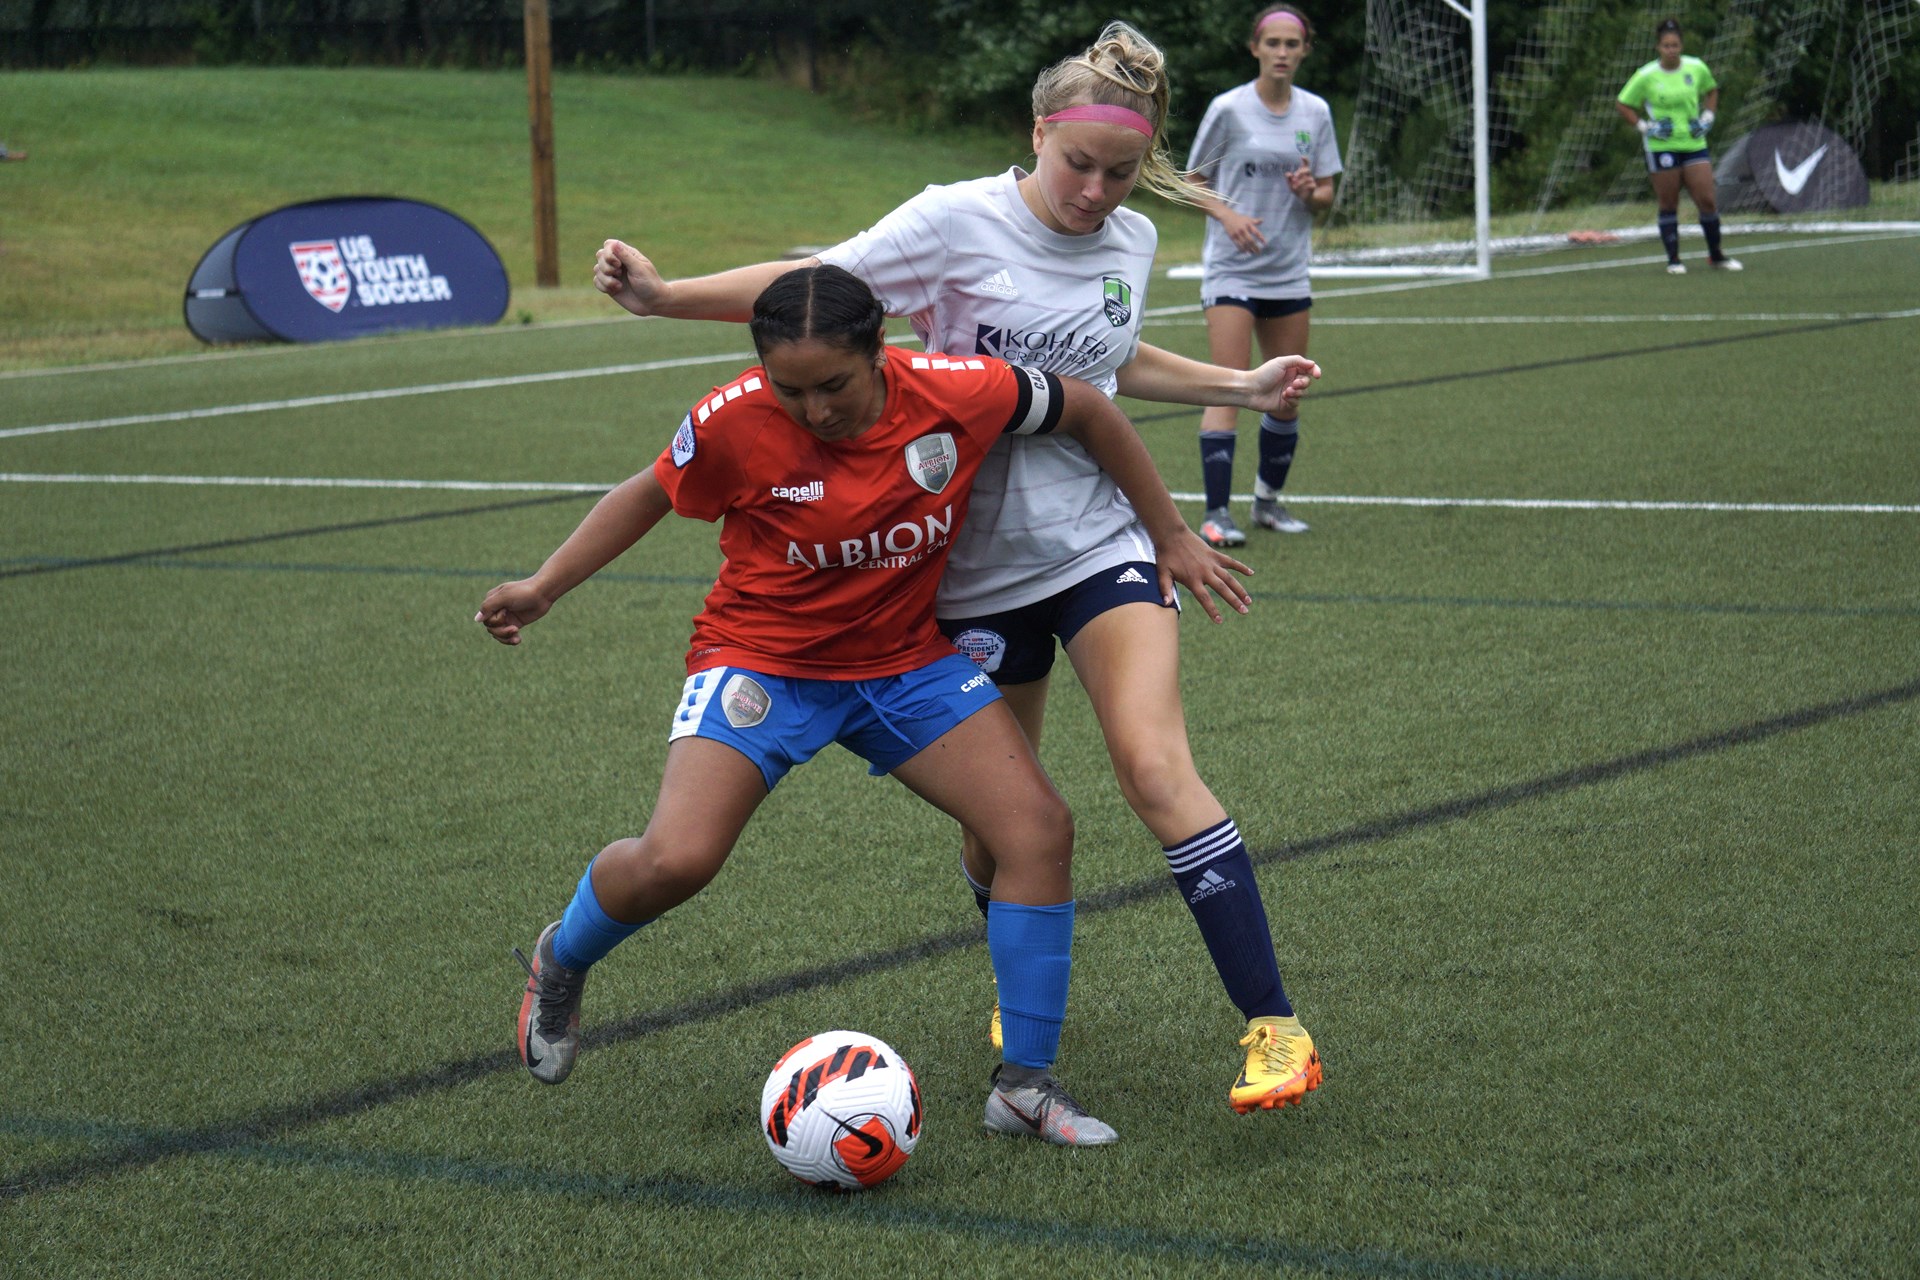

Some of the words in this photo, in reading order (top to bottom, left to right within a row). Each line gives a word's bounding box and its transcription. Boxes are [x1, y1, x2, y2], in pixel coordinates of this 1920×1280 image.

[339, 234, 377, 261] US
[347, 254, 430, 283] YOUTH
[356, 275, 452, 306] SOCCER
[980, 282, 1018, 296] adidas
[1005, 329, 1108, 362] KOHLER
[918, 453, 949, 471] ALBION
[771, 481, 824, 501] capelli
[786, 504, 952, 571] ALBION
[857, 552, 923, 570] CENTRAL
[927, 536, 949, 554] CAL
[957, 643, 999, 652] PRESIDENTS
[1190, 880, 1236, 904] adidas
